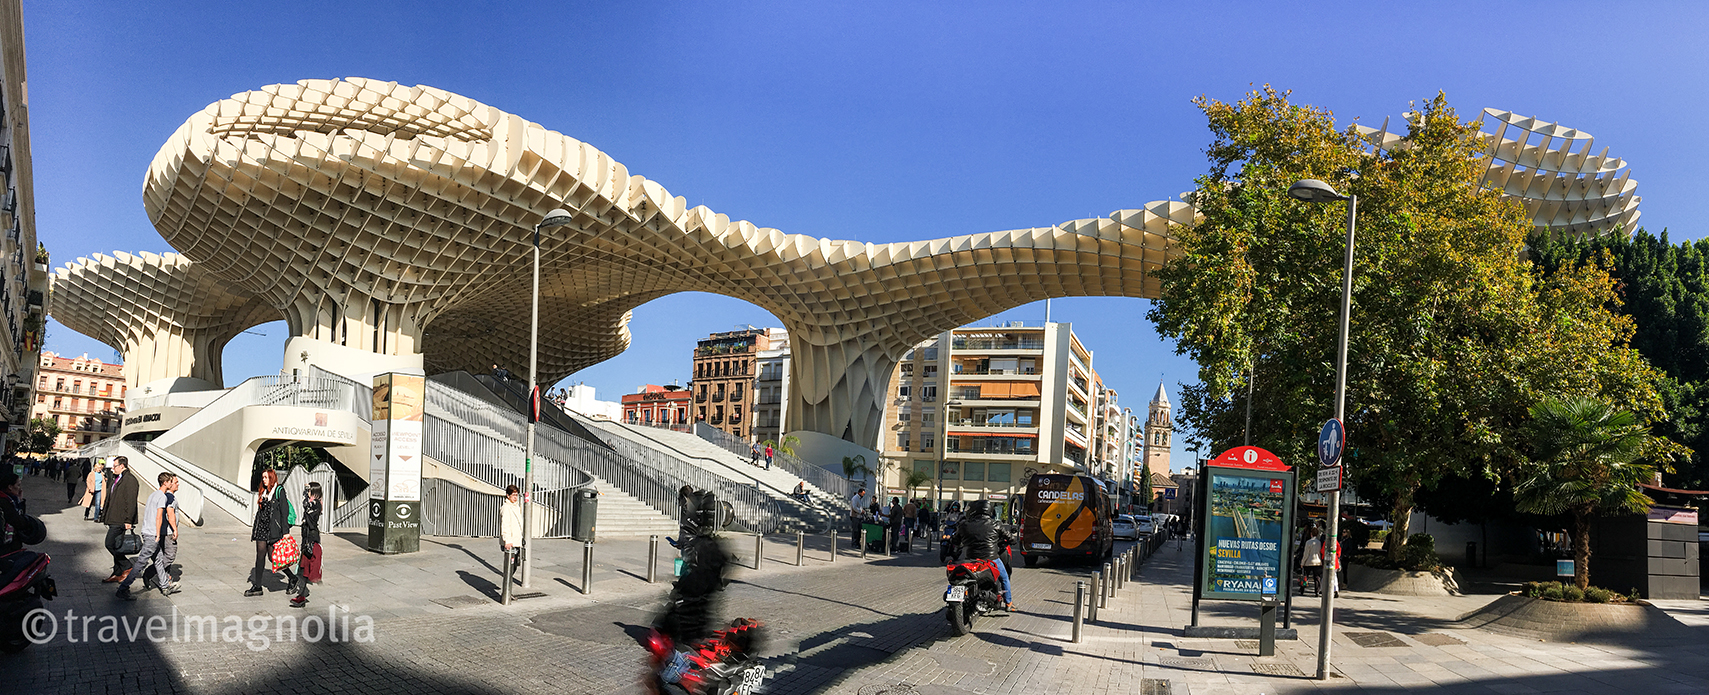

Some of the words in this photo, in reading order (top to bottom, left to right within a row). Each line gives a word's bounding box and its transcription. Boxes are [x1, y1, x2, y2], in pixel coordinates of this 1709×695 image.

[327, 429, 336, 438] DE
[1037, 490, 1085, 501] CANDELAS
[388, 521, 402, 529] Past
[1218, 539, 1241, 549] NUEVAS
[1241, 540, 1259, 550] RUTAS
[1259, 542, 1277, 551] DESDE
[1217, 549, 1241, 559] SEVILLA
